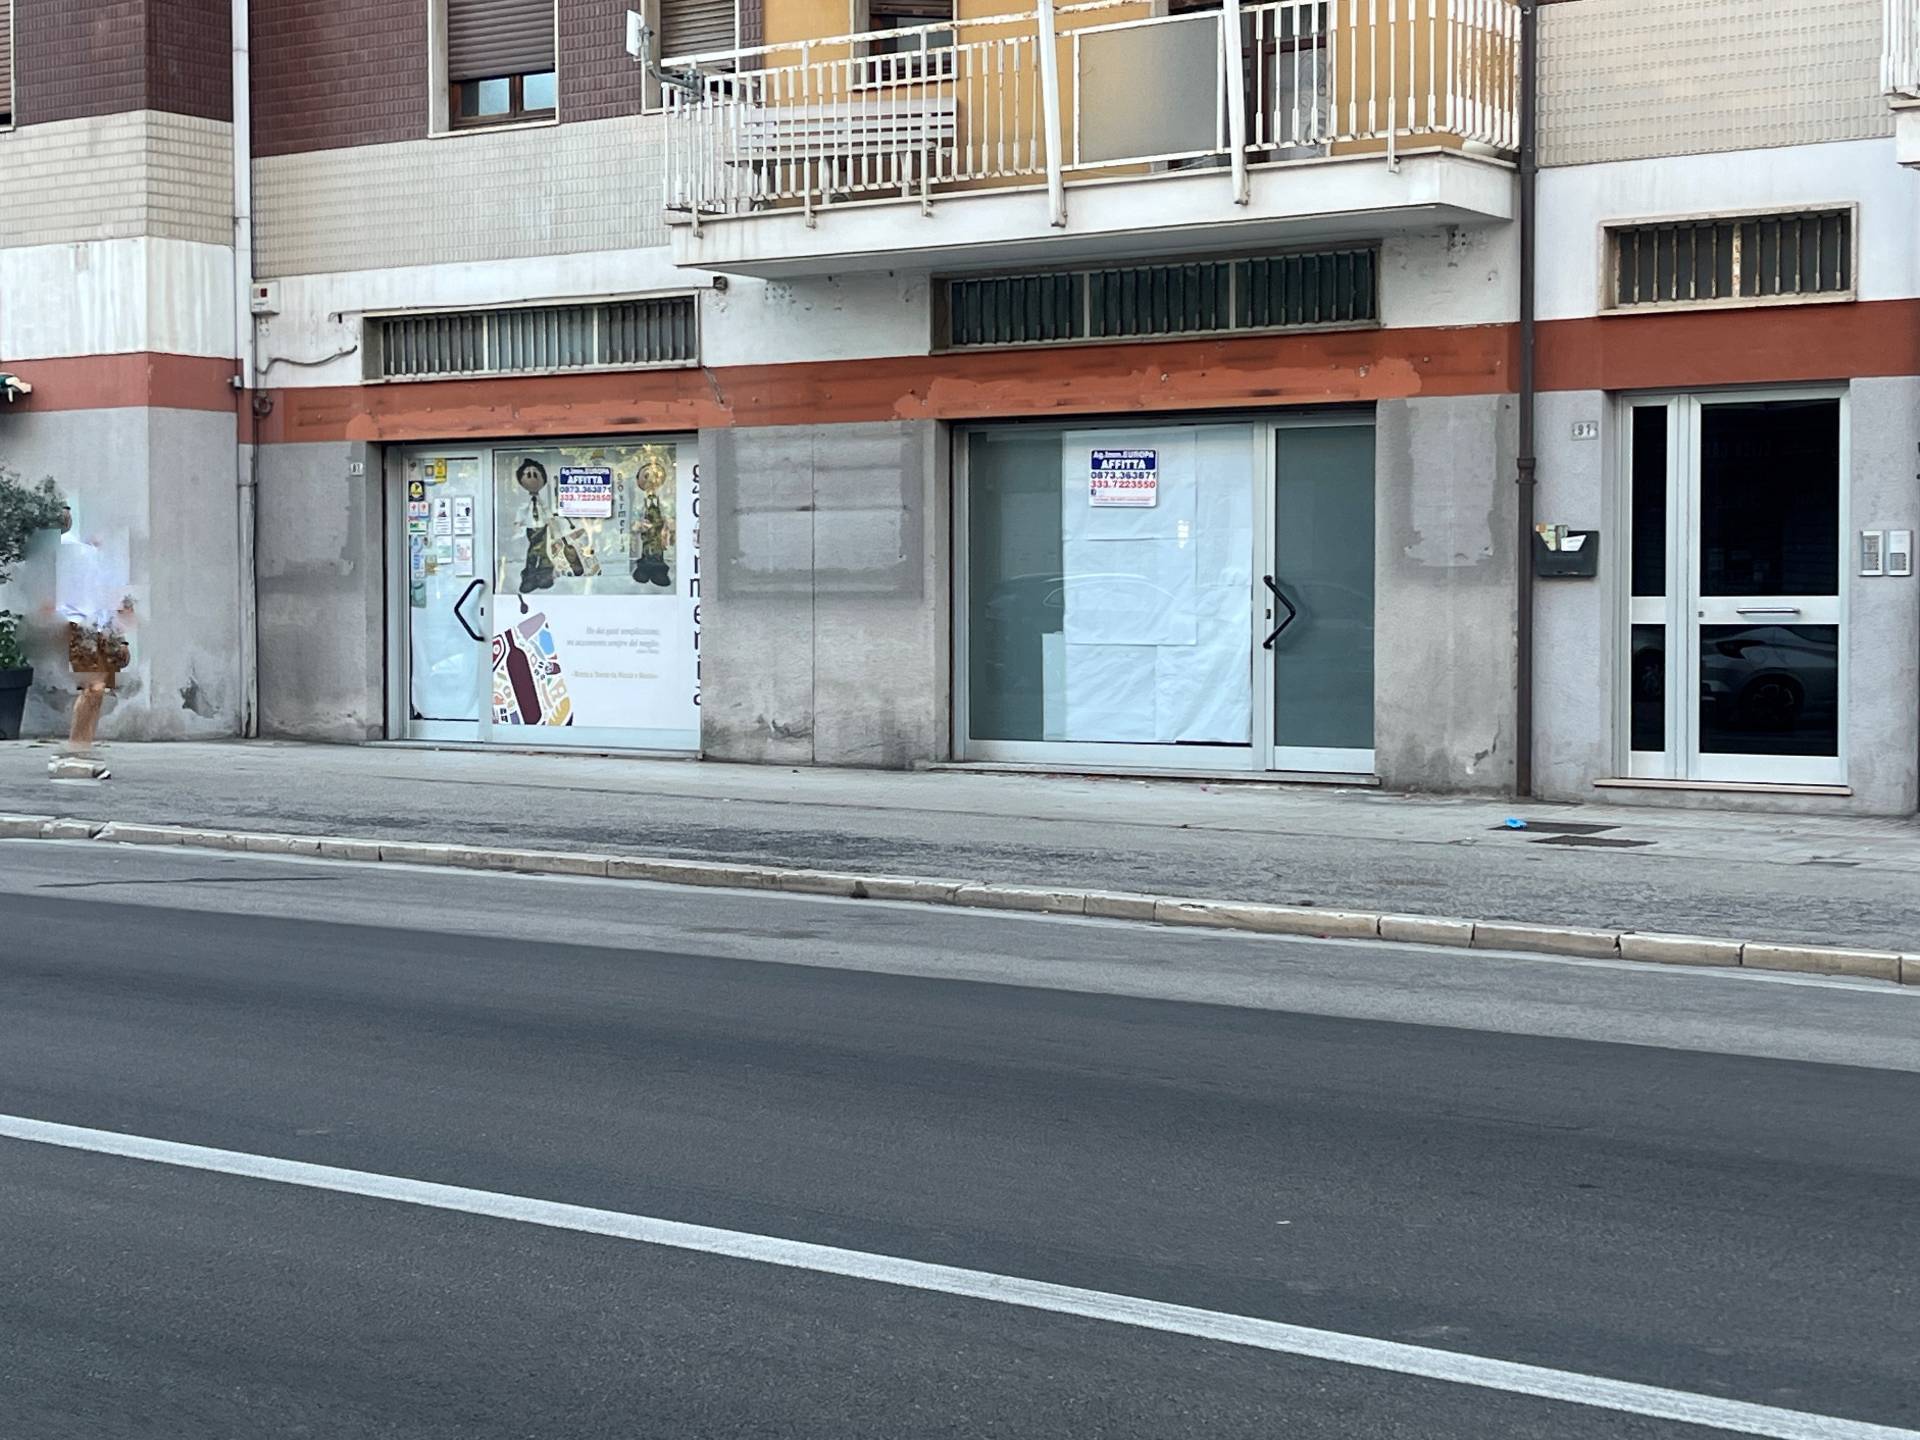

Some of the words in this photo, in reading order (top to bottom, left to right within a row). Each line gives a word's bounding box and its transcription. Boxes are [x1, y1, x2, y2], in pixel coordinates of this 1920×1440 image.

[1101, 459, 1146, 470] AFFITTA
[567, 475, 604, 485] AFFITTA
[1090, 480, 1156, 489] 333.7223550
